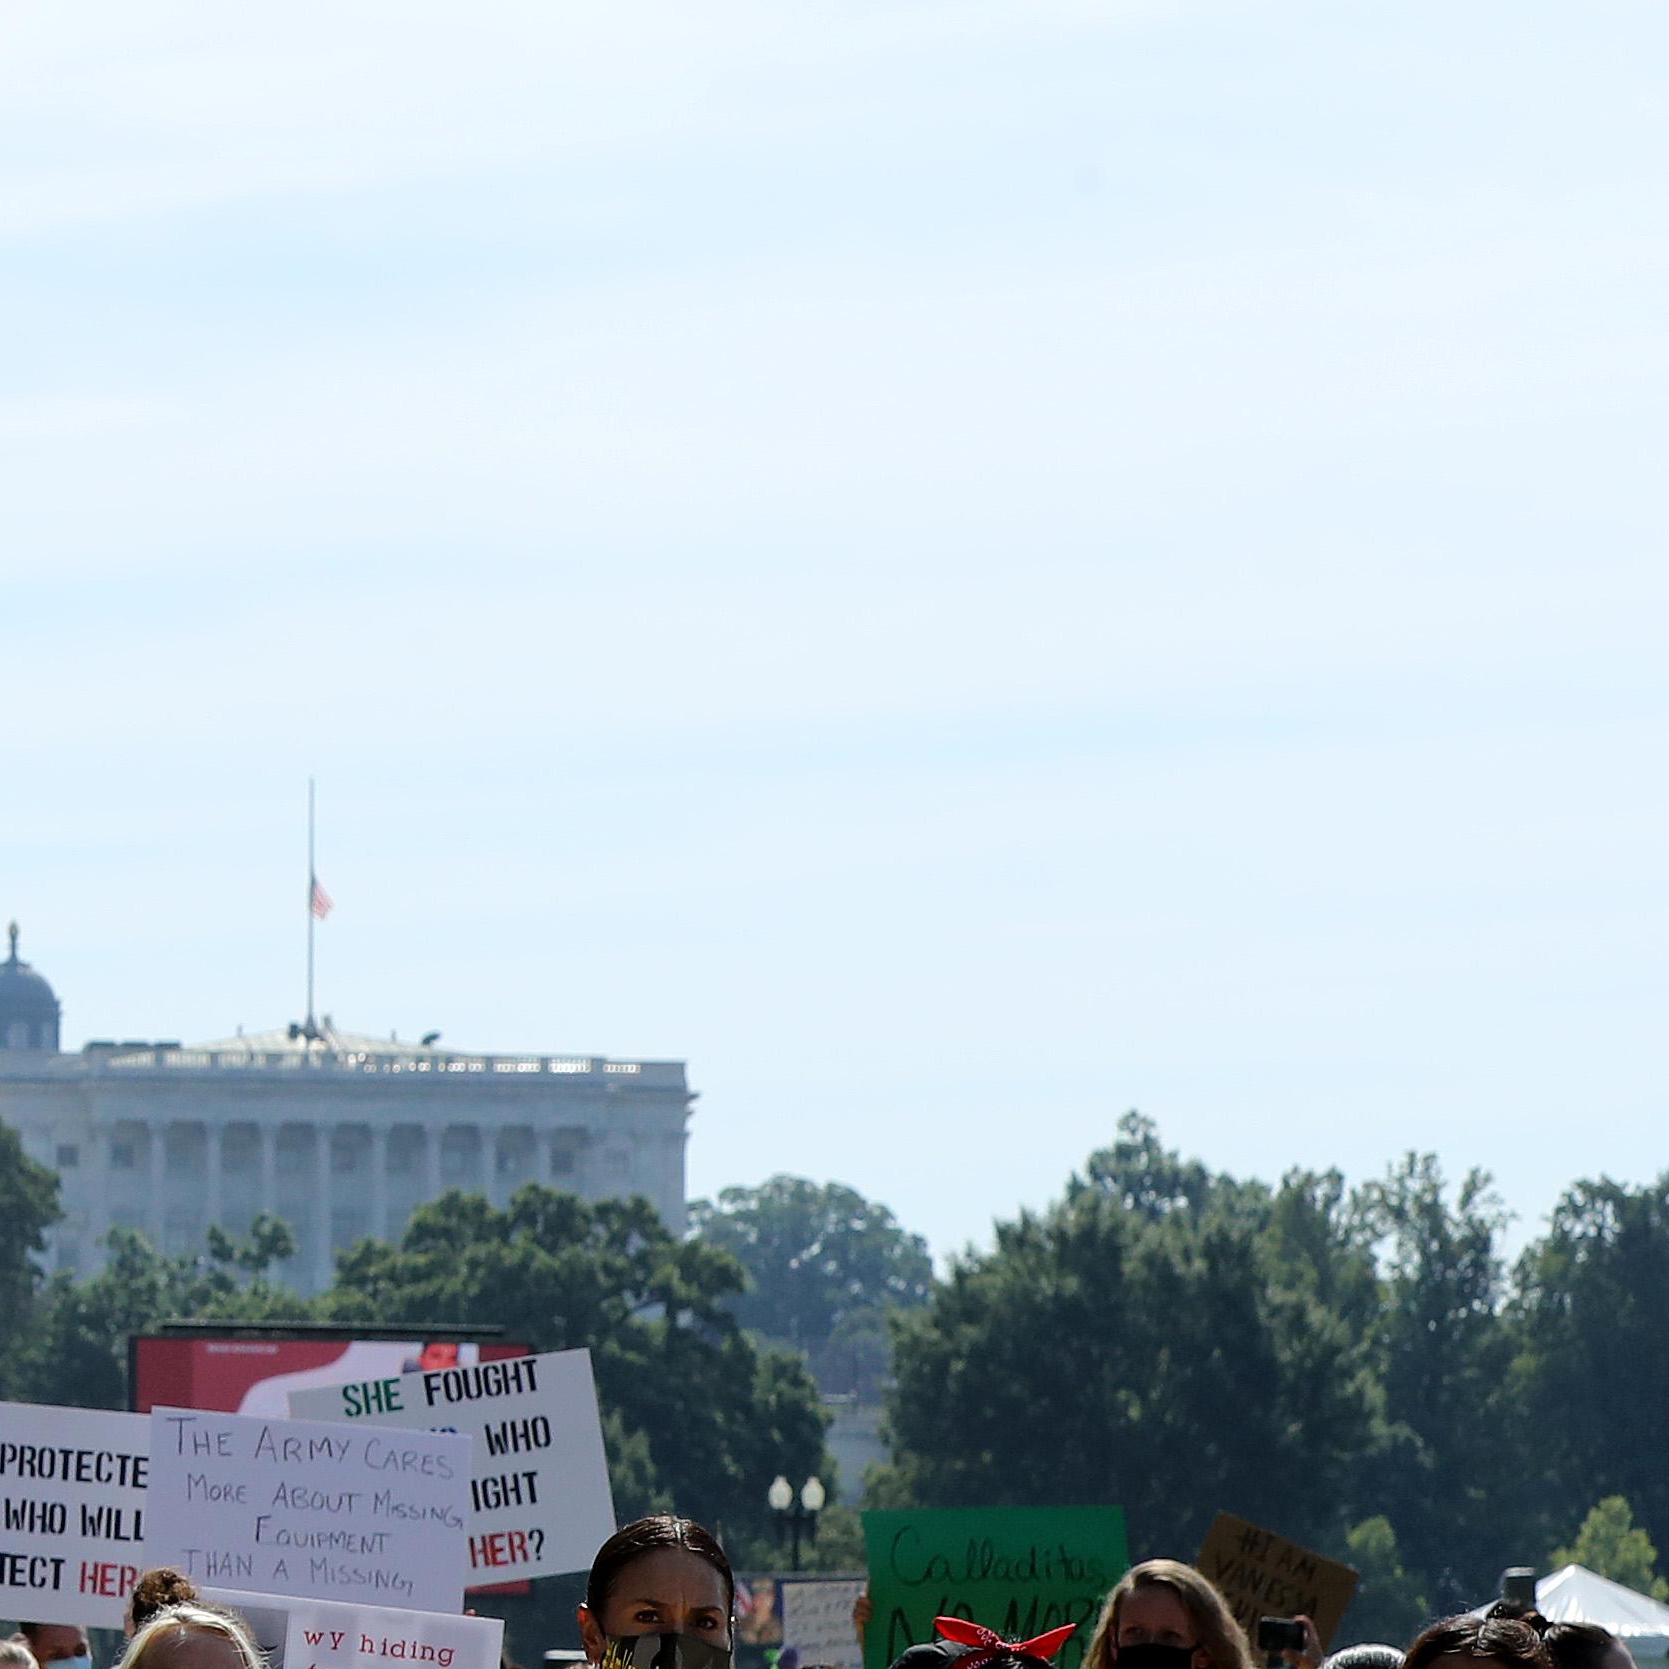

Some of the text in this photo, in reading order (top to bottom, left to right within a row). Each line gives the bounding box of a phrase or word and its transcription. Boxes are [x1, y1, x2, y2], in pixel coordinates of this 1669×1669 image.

[343, 1359, 538, 1417] SHE FOUGHT
[166, 1417, 454, 1479] THE ARMY CARES
[485, 1416, 551, 1457] WHO
[0, 1443, 150, 1488] PROTECTE
[272, 1482, 362, 1514] ABOUT
[471, 1472, 538, 1512] IGHT
[5, 1497, 66, 1535] WHO
[81, 1503, 144, 1541] WILL
[181, 1549, 253, 1577] THAN
[273, 1558, 288, 1579] A
[469, 1529, 544, 1568] HER?
[79, 1561, 139, 1597] HER
[359, 1635, 455, 1667] hiding
